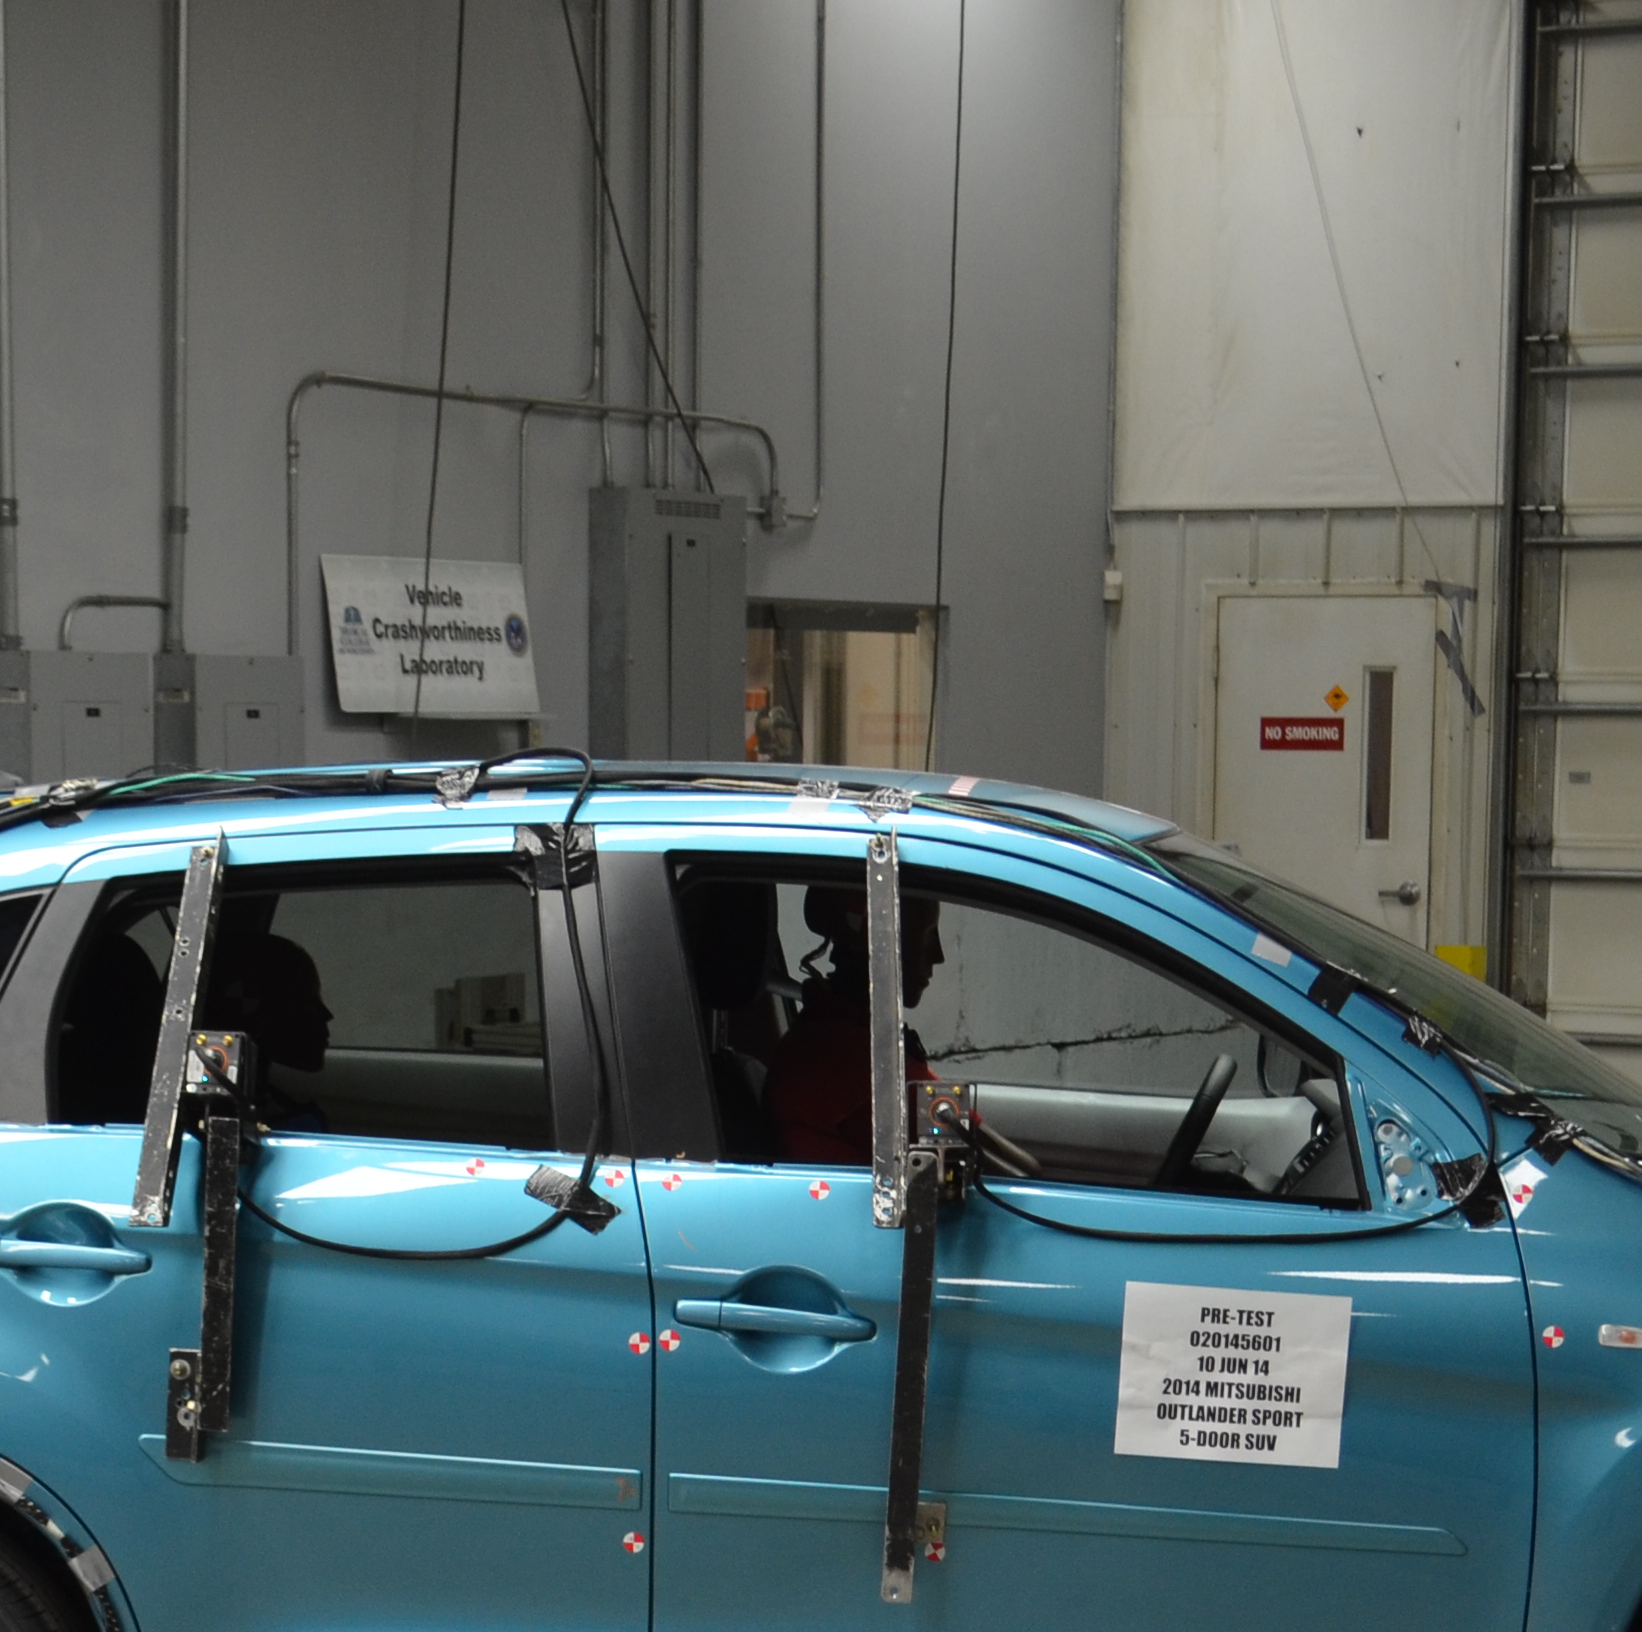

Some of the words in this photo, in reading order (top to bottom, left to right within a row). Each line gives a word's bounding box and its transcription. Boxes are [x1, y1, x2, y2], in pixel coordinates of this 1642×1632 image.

[404, 584, 464, 608] Vehicle
[372, 617, 503, 644] Crashworthiness
[399, 653, 484, 682] Laboratory
[1265, 726, 1282, 741] NO
[1285, 726, 1339, 741] SMOKING
[1200, 1307, 1275, 1328] PRE-TEST
[1189, 1330, 1281, 1353] 020145601
[1197, 1355, 1216, 1373] 10
[1218, 1356, 1249, 1375] JUN
[1253, 1359, 1270, 1376] 14
[1162, 1377, 1201, 1397] 2014
[1205, 1380, 1301, 1404] MITSUBISHI
[1156, 1402, 1248, 1425] OUTLANDER
[1251, 1408, 1304, 1428] SPORT
[1179, 1429, 1241, 1450] 5-DOOR
[1244, 1433, 1277, 1452] SUV
